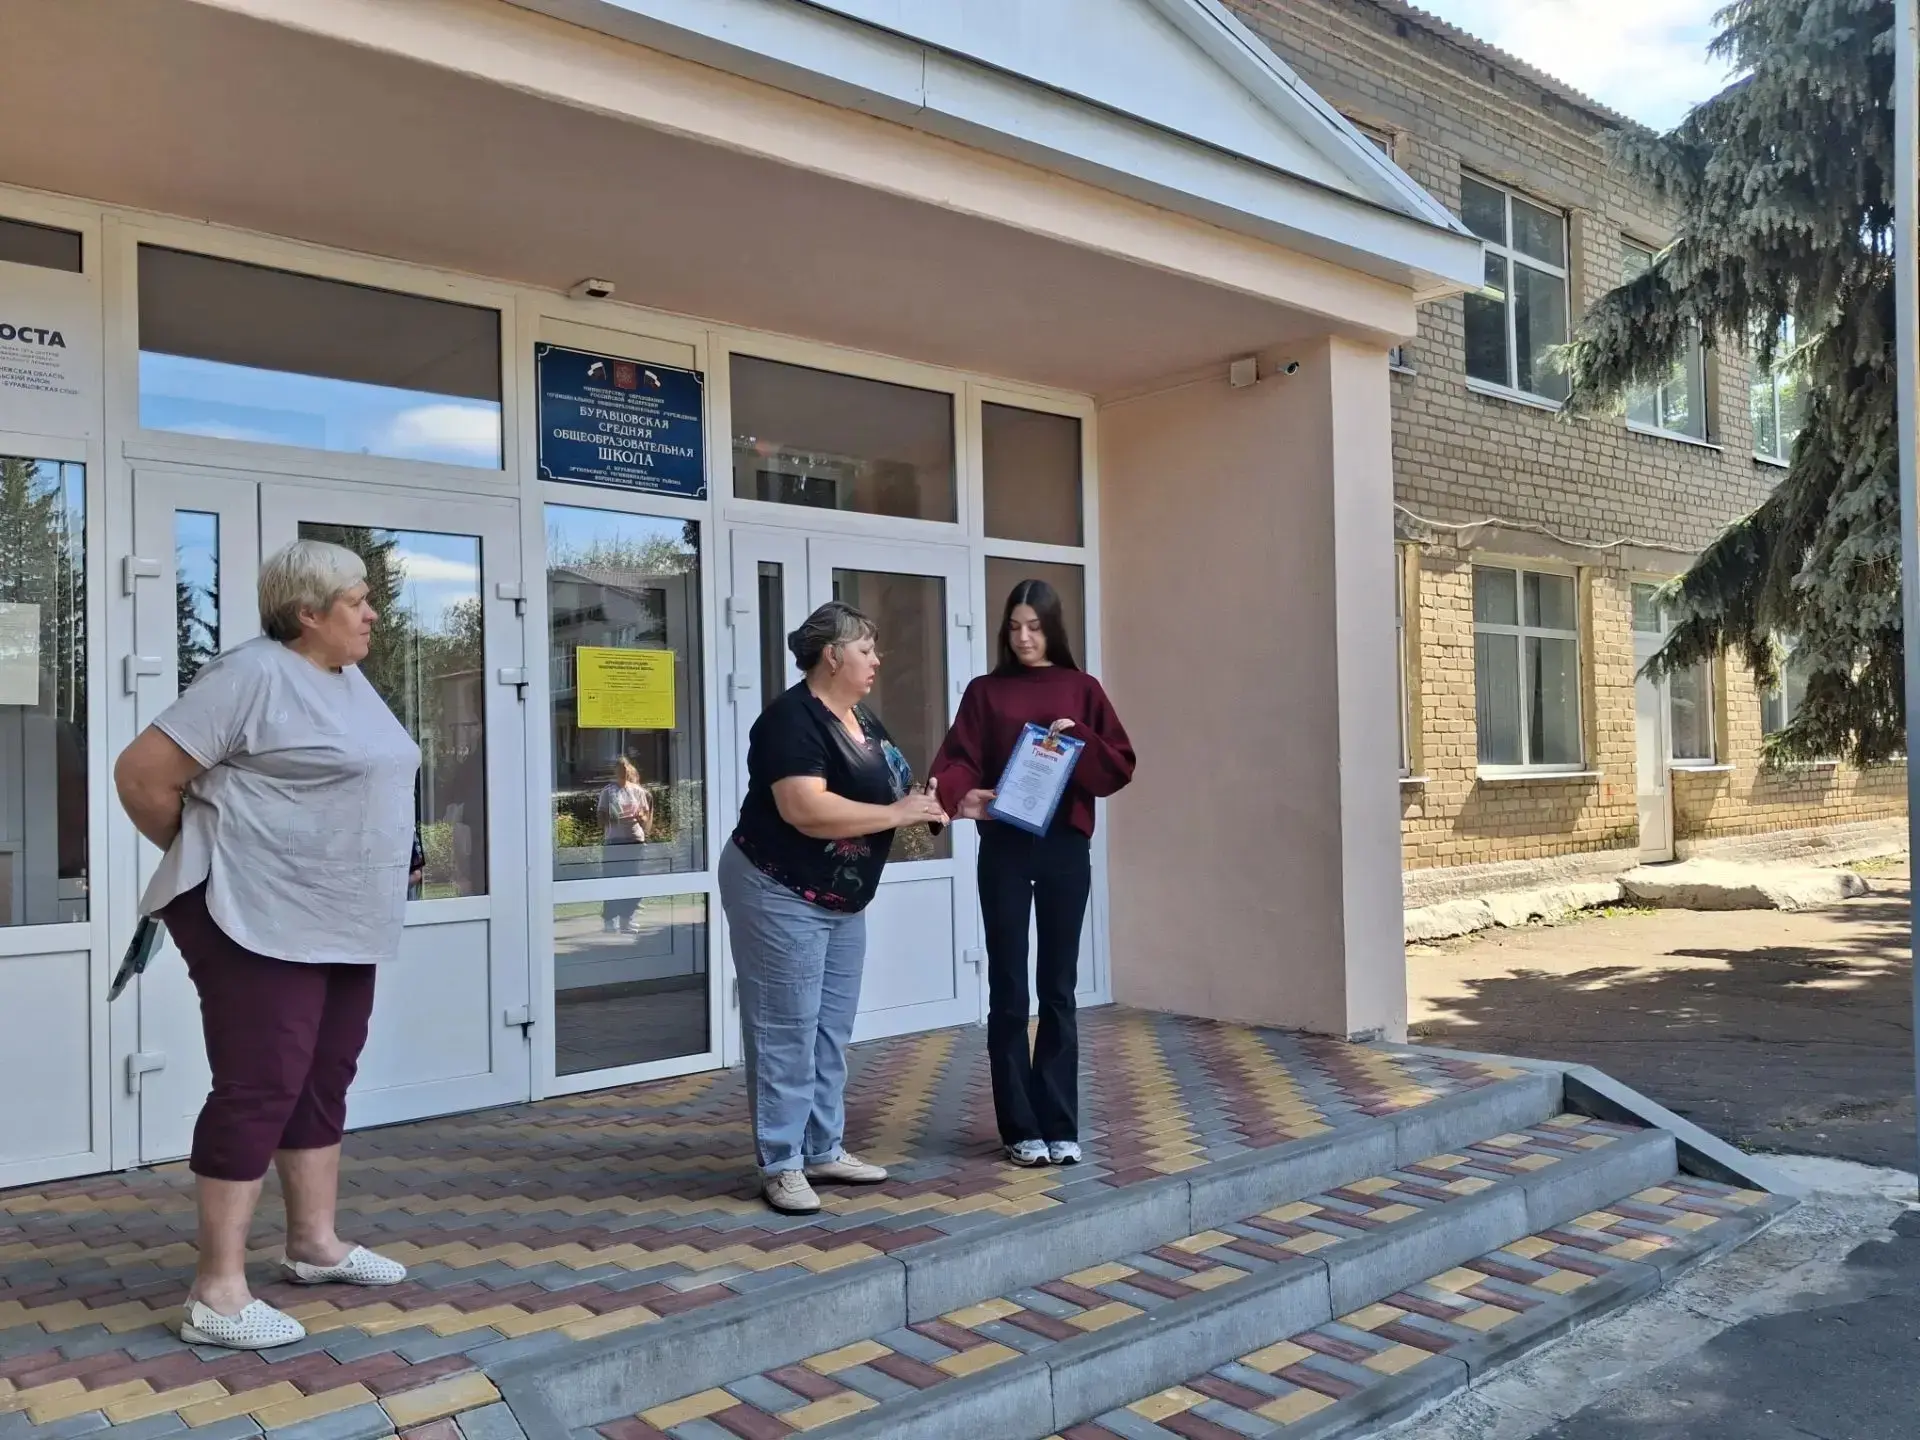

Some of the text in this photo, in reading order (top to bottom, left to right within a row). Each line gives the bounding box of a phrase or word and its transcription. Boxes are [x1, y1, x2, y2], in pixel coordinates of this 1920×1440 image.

[0, 323, 66, 348] ОСТА
[33, 370, 65, 380] ОБЛАСТЬ
[580, 406, 669, 429] БУРАВЦОВСКАЯ
[598, 422, 652, 439] СРЕДНЯЯ
[553, 428, 694, 458] ОБЩЕОБРАЗОВАТЕЛЬНАЯ
[598, 447, 654, 467] ШКОЛА
[1032, 747, 1058, 762] Грамота
